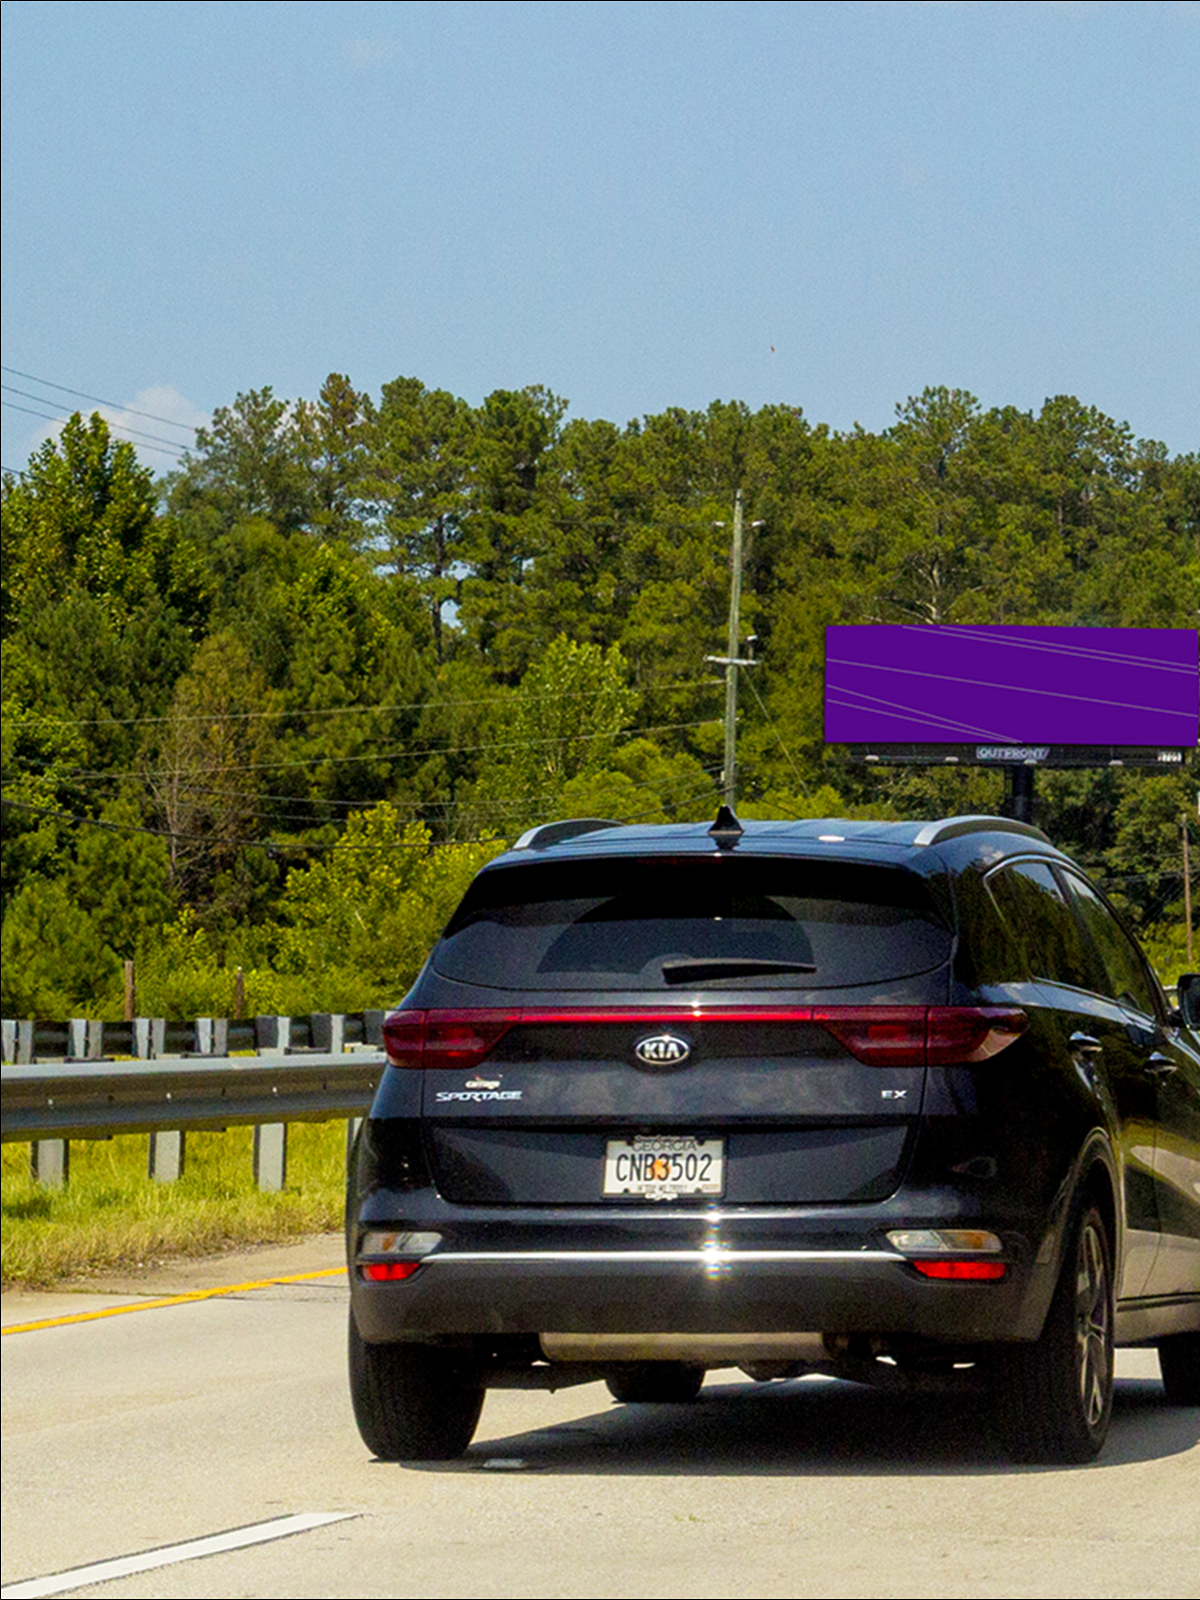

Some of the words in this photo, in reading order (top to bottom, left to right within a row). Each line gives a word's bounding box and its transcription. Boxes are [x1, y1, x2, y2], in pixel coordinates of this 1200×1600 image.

[979, 747, 1045, 760] OUTFRONT
[644, 1042, 680, 1059] KIA
[435, 1090, 523, 1103] SPORTAGE
[881, 1089, 907, 1099] EX
[631, 1139, 698, 1152] GEORGIA
[615, 1153, 713, 1182] CNB3502
